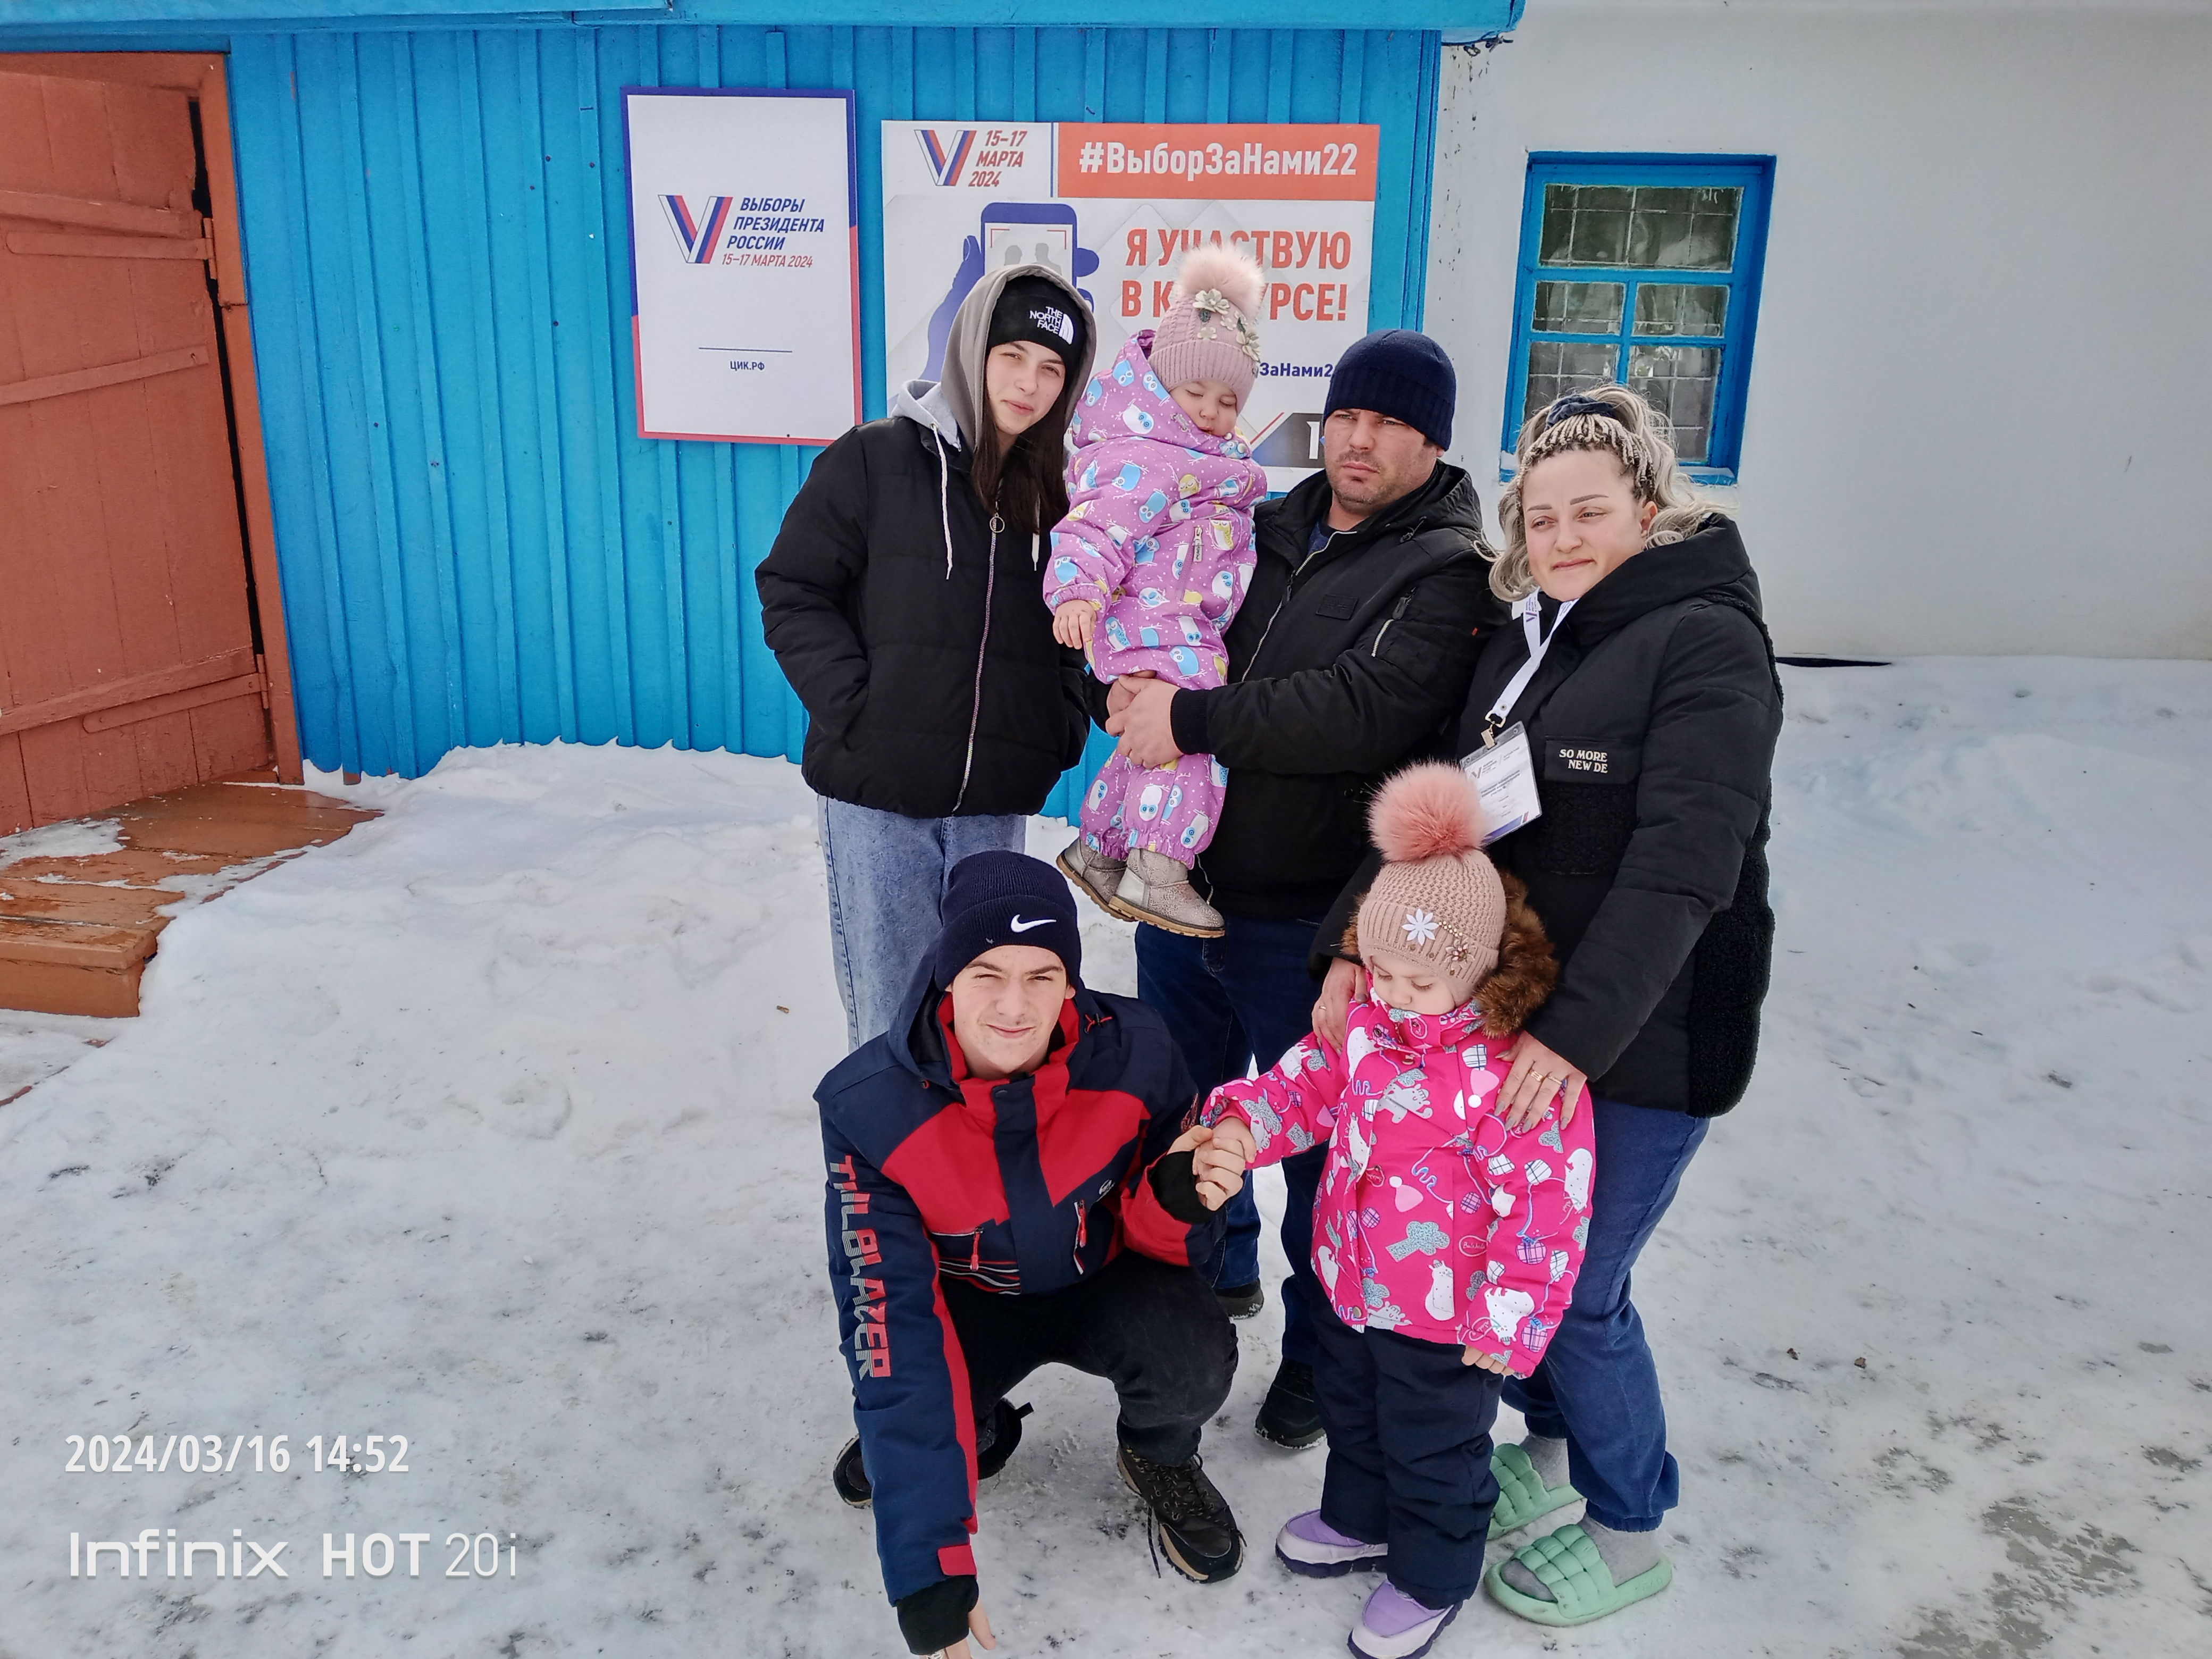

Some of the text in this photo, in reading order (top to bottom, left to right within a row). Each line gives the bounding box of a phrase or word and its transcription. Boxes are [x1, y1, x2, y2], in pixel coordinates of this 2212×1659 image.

[975, 150, 1024, 167] МАРТА
[1079, 141, 1358, 181] #ВыборЗаНами22
[968, 170, 1002, 187] 2024
[740, 197, 805, 212] ВЫБОРЫ
[733, 216, 825, 233] ПРЕЗИДЕНТА
[727, 235, 786, 250] РОССИИ
[1126, 228, 1147, 266] Я
[751, 254, 786, 267] МАРТА
[787, 255, 813, 268] 2024
[1121, 280, 1347, 321] В КРСЕ!
[1029, 310, 1061, 327] NORTH
[1045, 306, 1063, 320] THE
[1037, 319, 1060, 334] FACE
[730, 361, 765, 371] ЦИК.РФ
[1259, 362, 1334, 377] ЗаНами2
[1559, 749, 1608, 763] SO MORE
[1568, 759, 1608, 774] NEW DE
